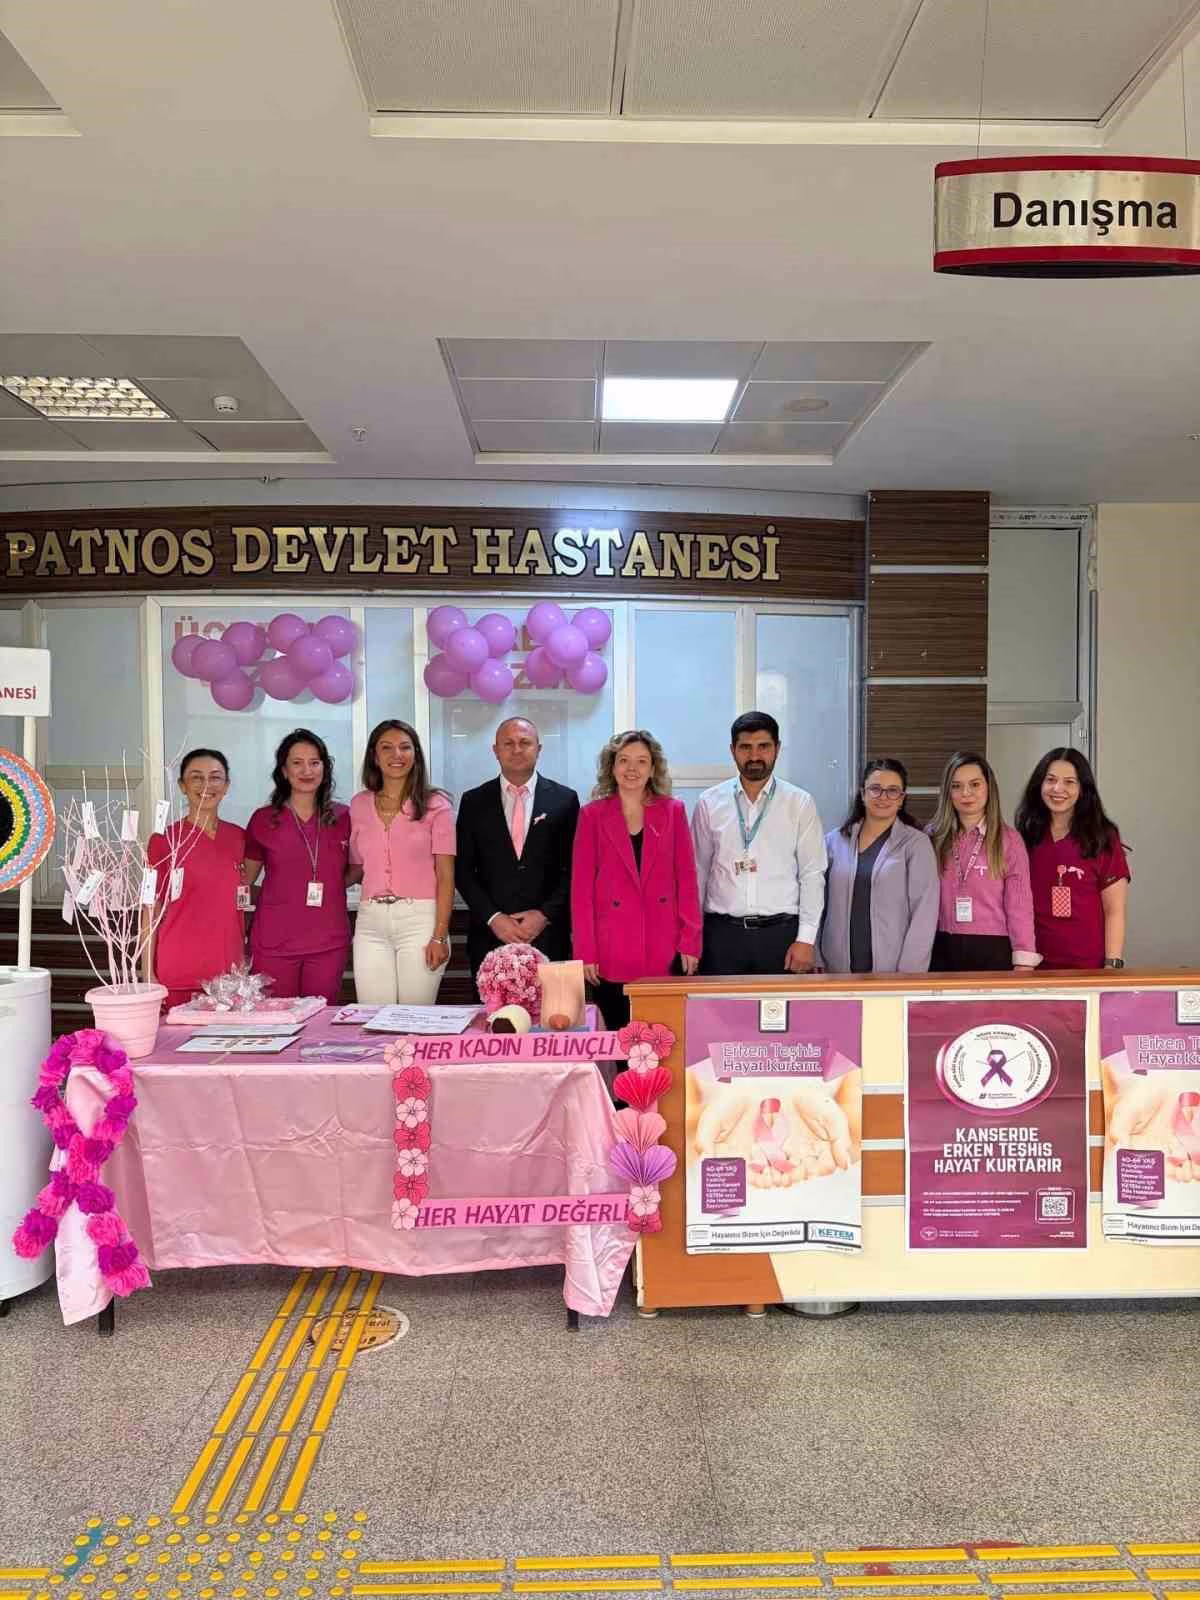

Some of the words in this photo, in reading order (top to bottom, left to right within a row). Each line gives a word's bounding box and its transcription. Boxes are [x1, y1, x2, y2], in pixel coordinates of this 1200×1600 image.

[993, 192, 1177, 236] Danışma
[5, 527, 215, 576] PATNOS
[231, 526, 458, 575] DEVLET
[471, 524, 781, 581] HASTANESİ
[414, 1041, 452, 1060] HER
[459, 1038, 522, 1058] KADIN
[532, 1033, 617, 1060] BİLİNÇLİ
[955, 1127, 1039, 1142] KANSERDE
[943, 1142, 994, 1158] ERKEN
[934, 1158, 980, 1174] HAYAT
[986, 1157, 1062, 1173] KURTARIR
[415, 1206, 457, 1228] HER
[465, 1203, 536, 1225] HAYAT
[541, 1199, 630, 1224] DEĞERLİ
[817, 1227, 855, 1241] KETEM
